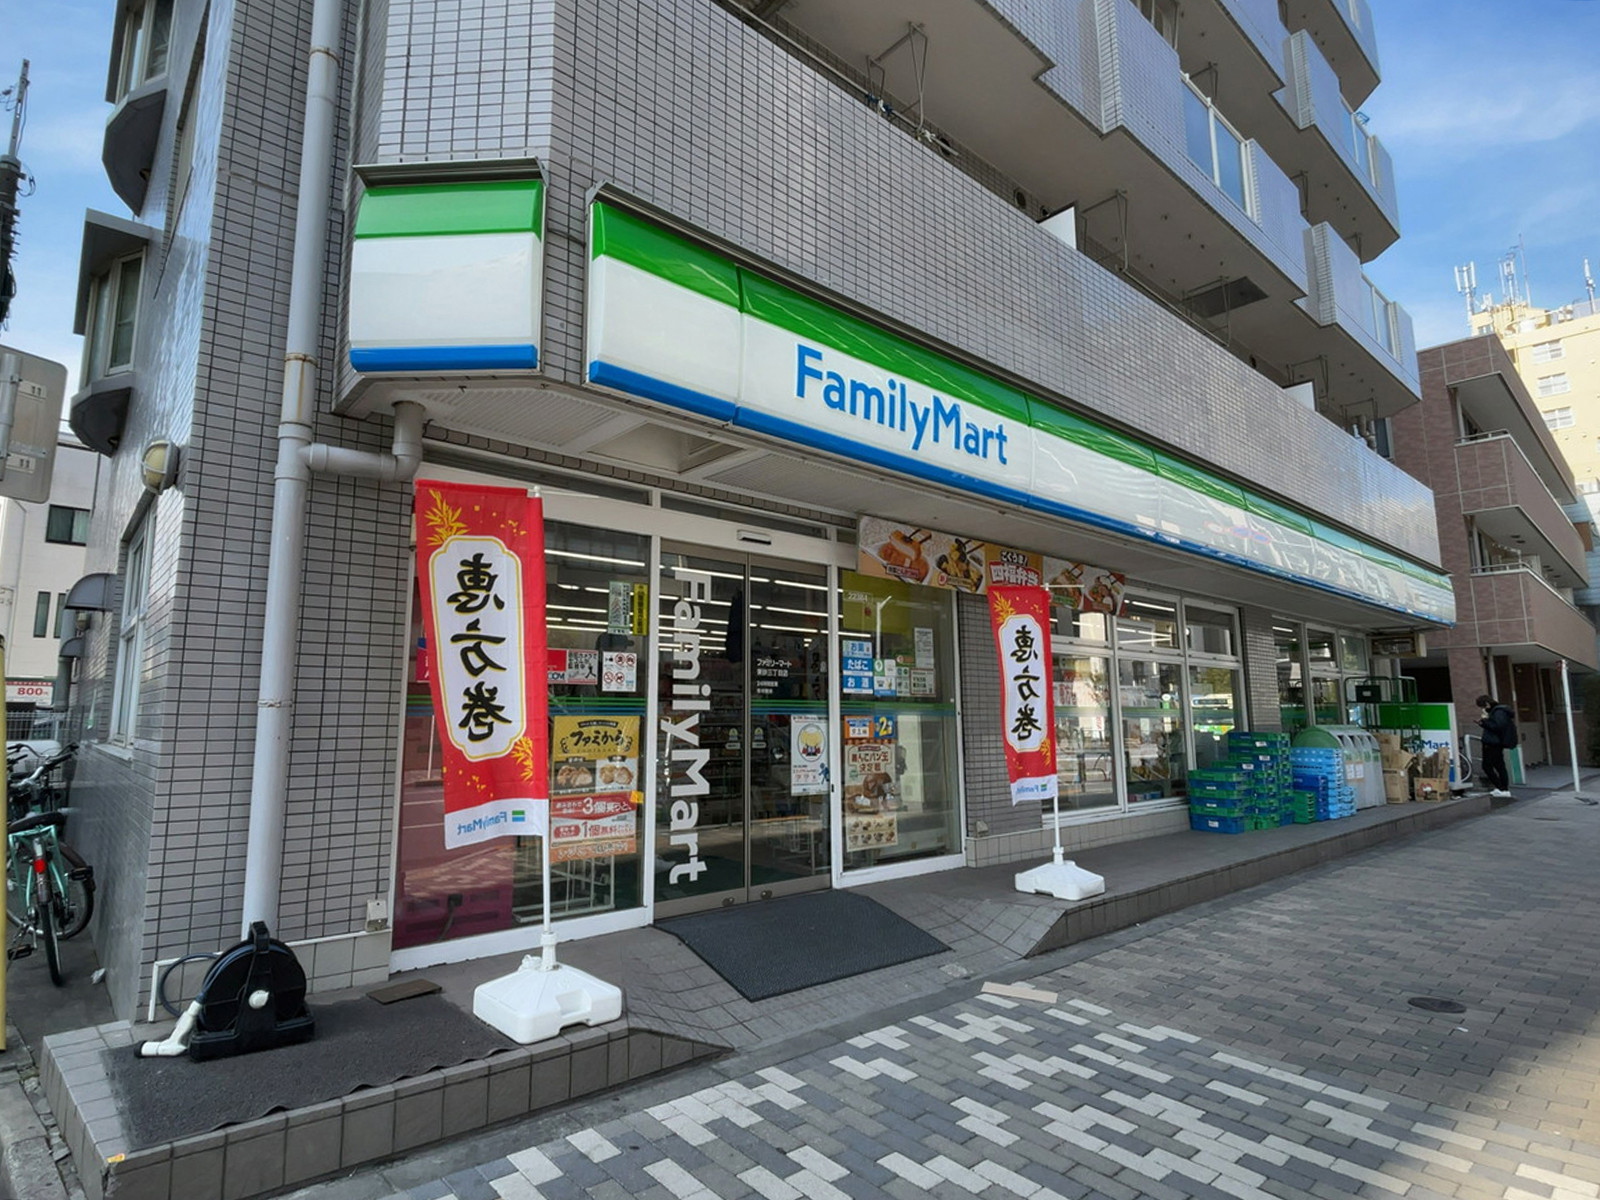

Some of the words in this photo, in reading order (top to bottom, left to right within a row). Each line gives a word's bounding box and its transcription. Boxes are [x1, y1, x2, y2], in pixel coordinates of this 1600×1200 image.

[796, 343, 1008, 465] FamilyMart
[847, 659, 869, 670] たばこ
[660, 569, 712, 884] FamilyMart
